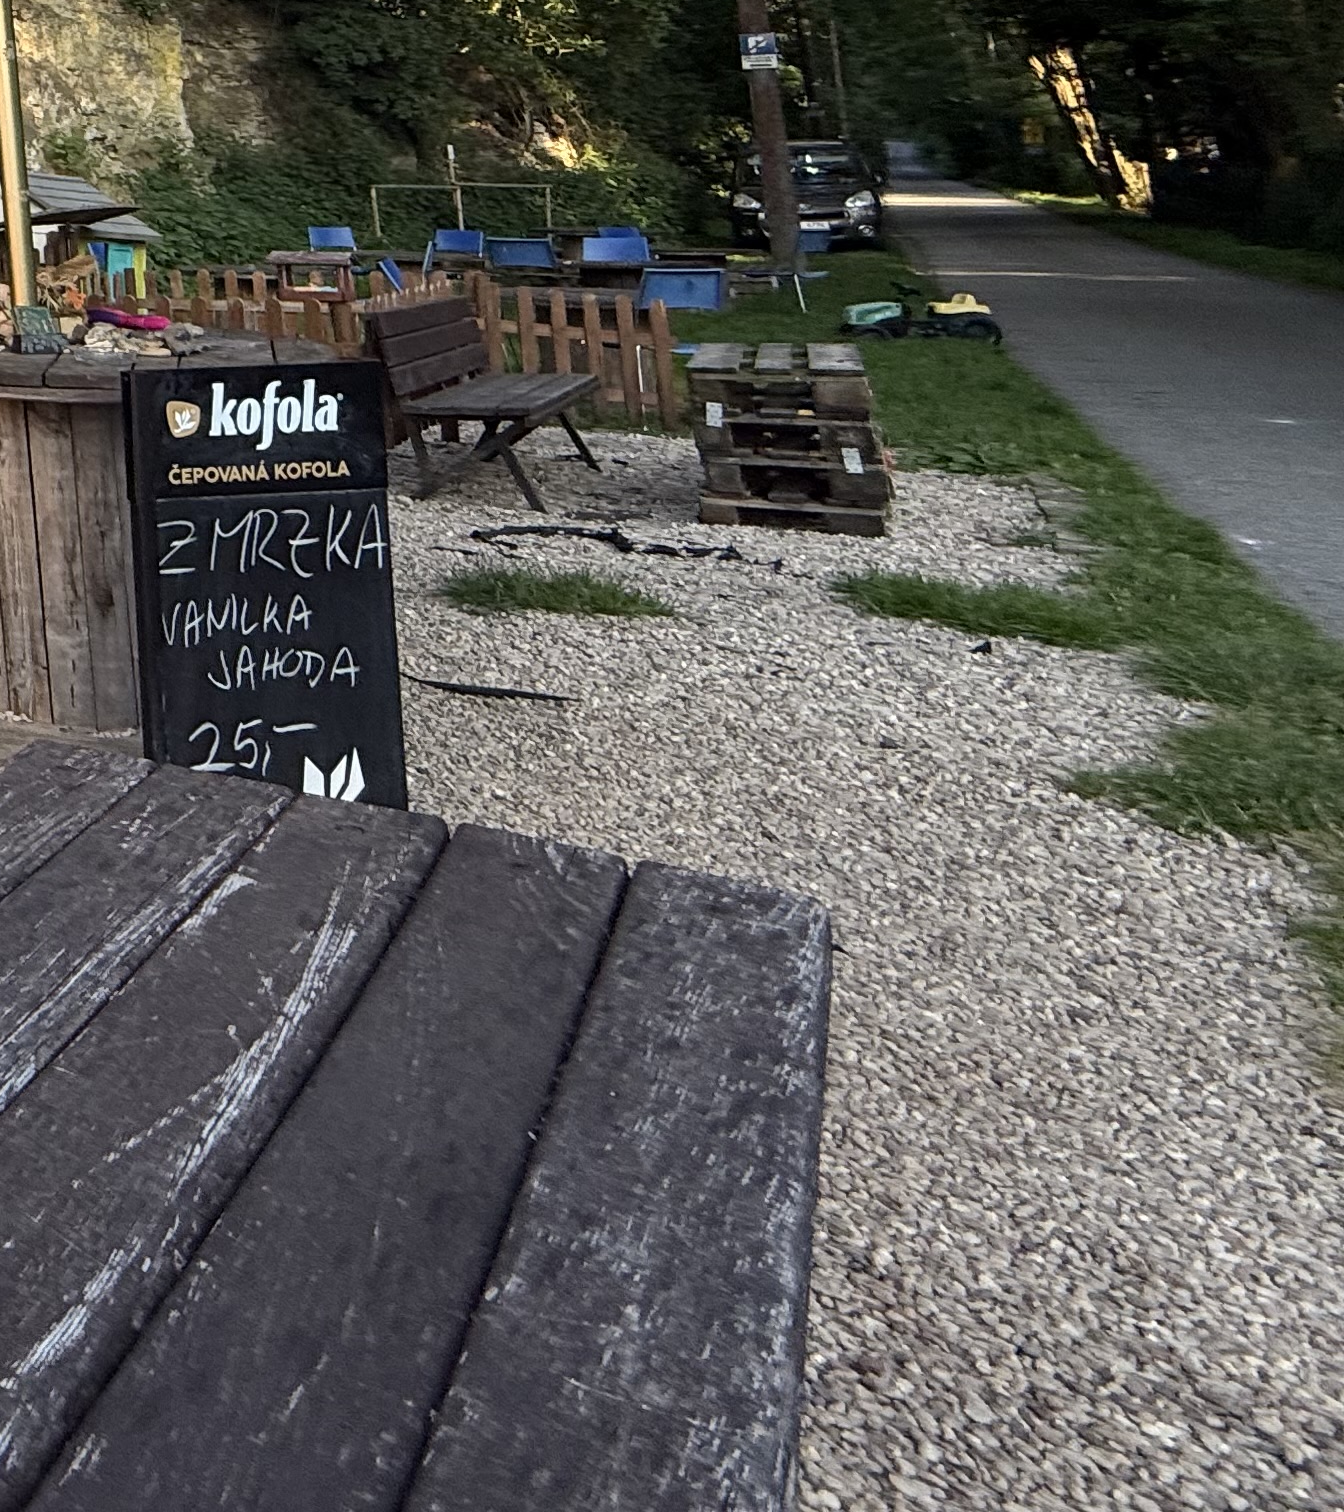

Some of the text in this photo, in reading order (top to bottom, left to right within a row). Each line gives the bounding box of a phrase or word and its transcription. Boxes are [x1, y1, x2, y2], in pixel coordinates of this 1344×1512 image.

[208, 378, 340, 451] kofola
[168, 459, 351, 486] ČEPOVANÁ KOFOLA
[161, 593, 314, 649] VANILKA
[208, 644, 361, 691] JAHODA
[188, 718, 318, 777] 25,-
